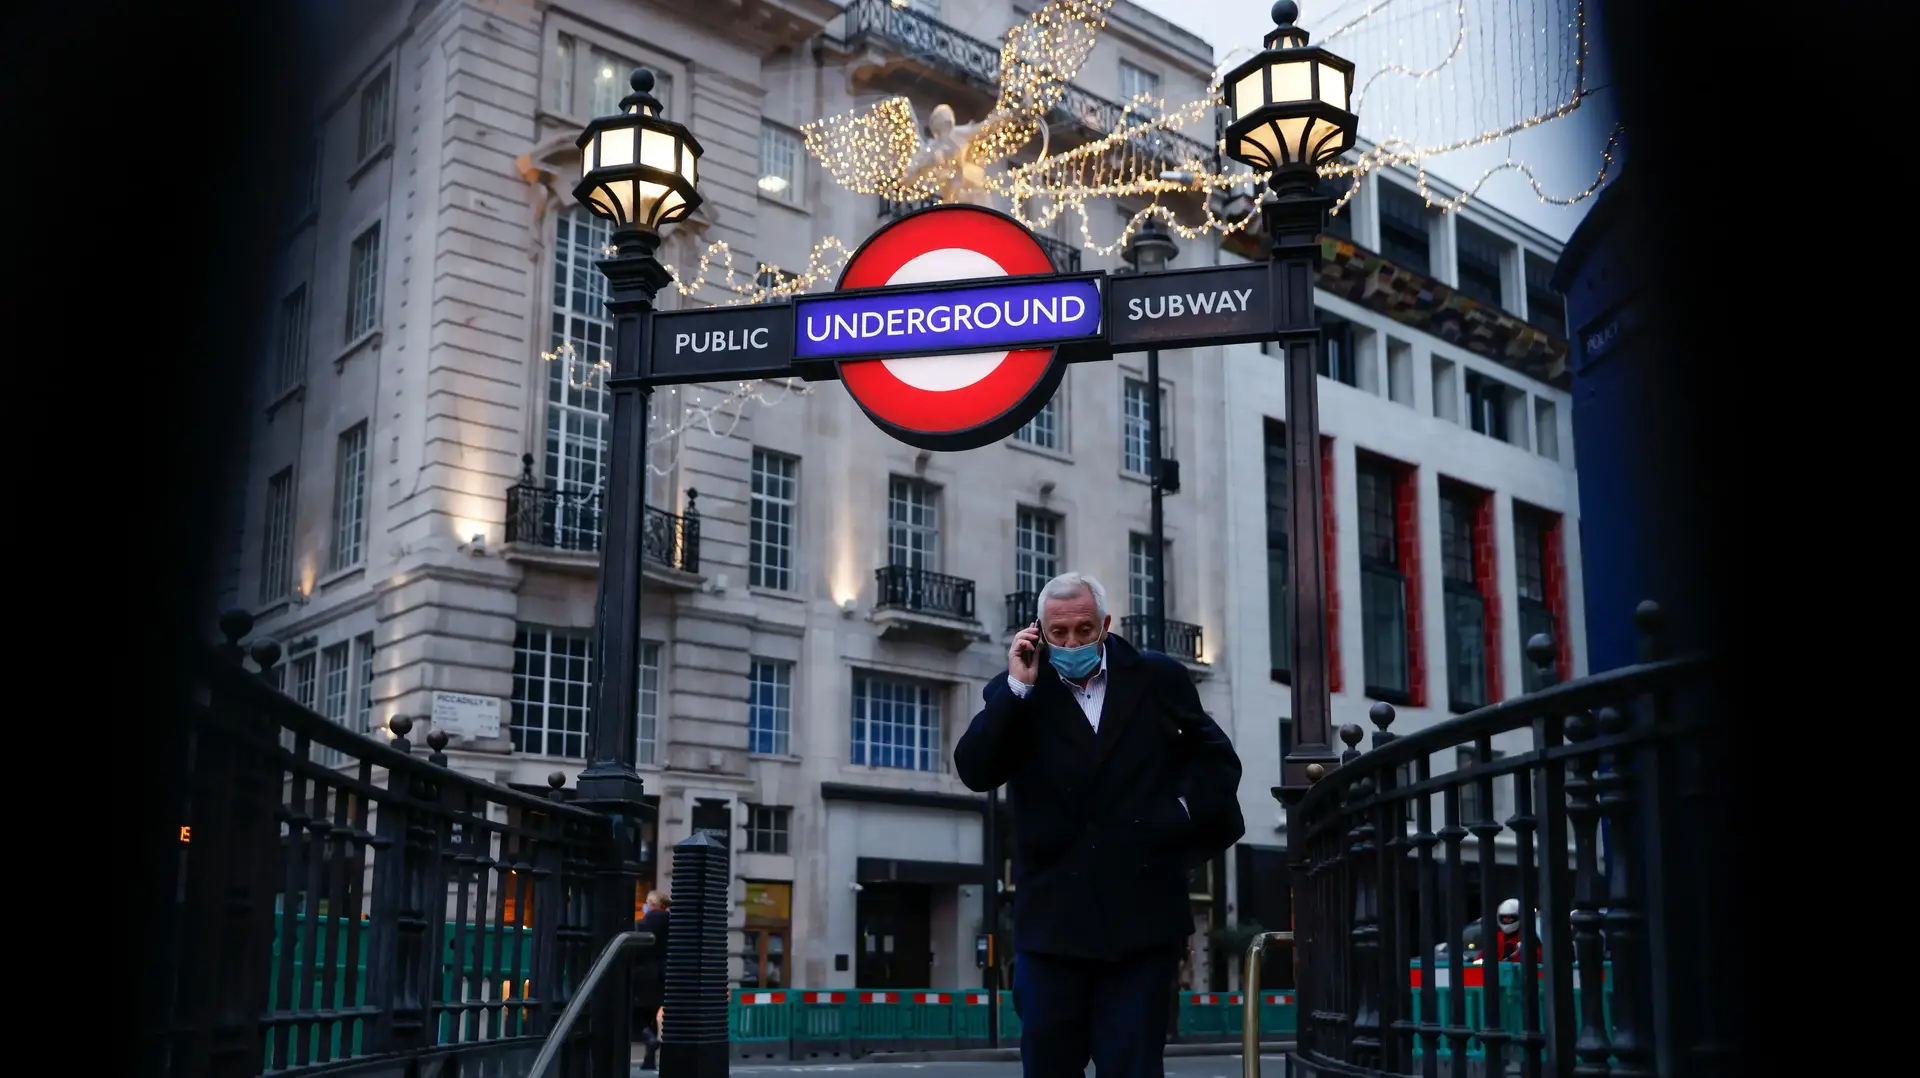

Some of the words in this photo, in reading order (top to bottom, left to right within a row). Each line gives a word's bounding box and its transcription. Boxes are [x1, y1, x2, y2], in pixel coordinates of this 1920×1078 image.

[675, 327, 769, 355] PUBLIC
[806, 295, 1086, 342] UNDERGROUND
[1127, 288, 1253, 321] SUBWAY
[437, 693, 484, 706] PICCADILLY
